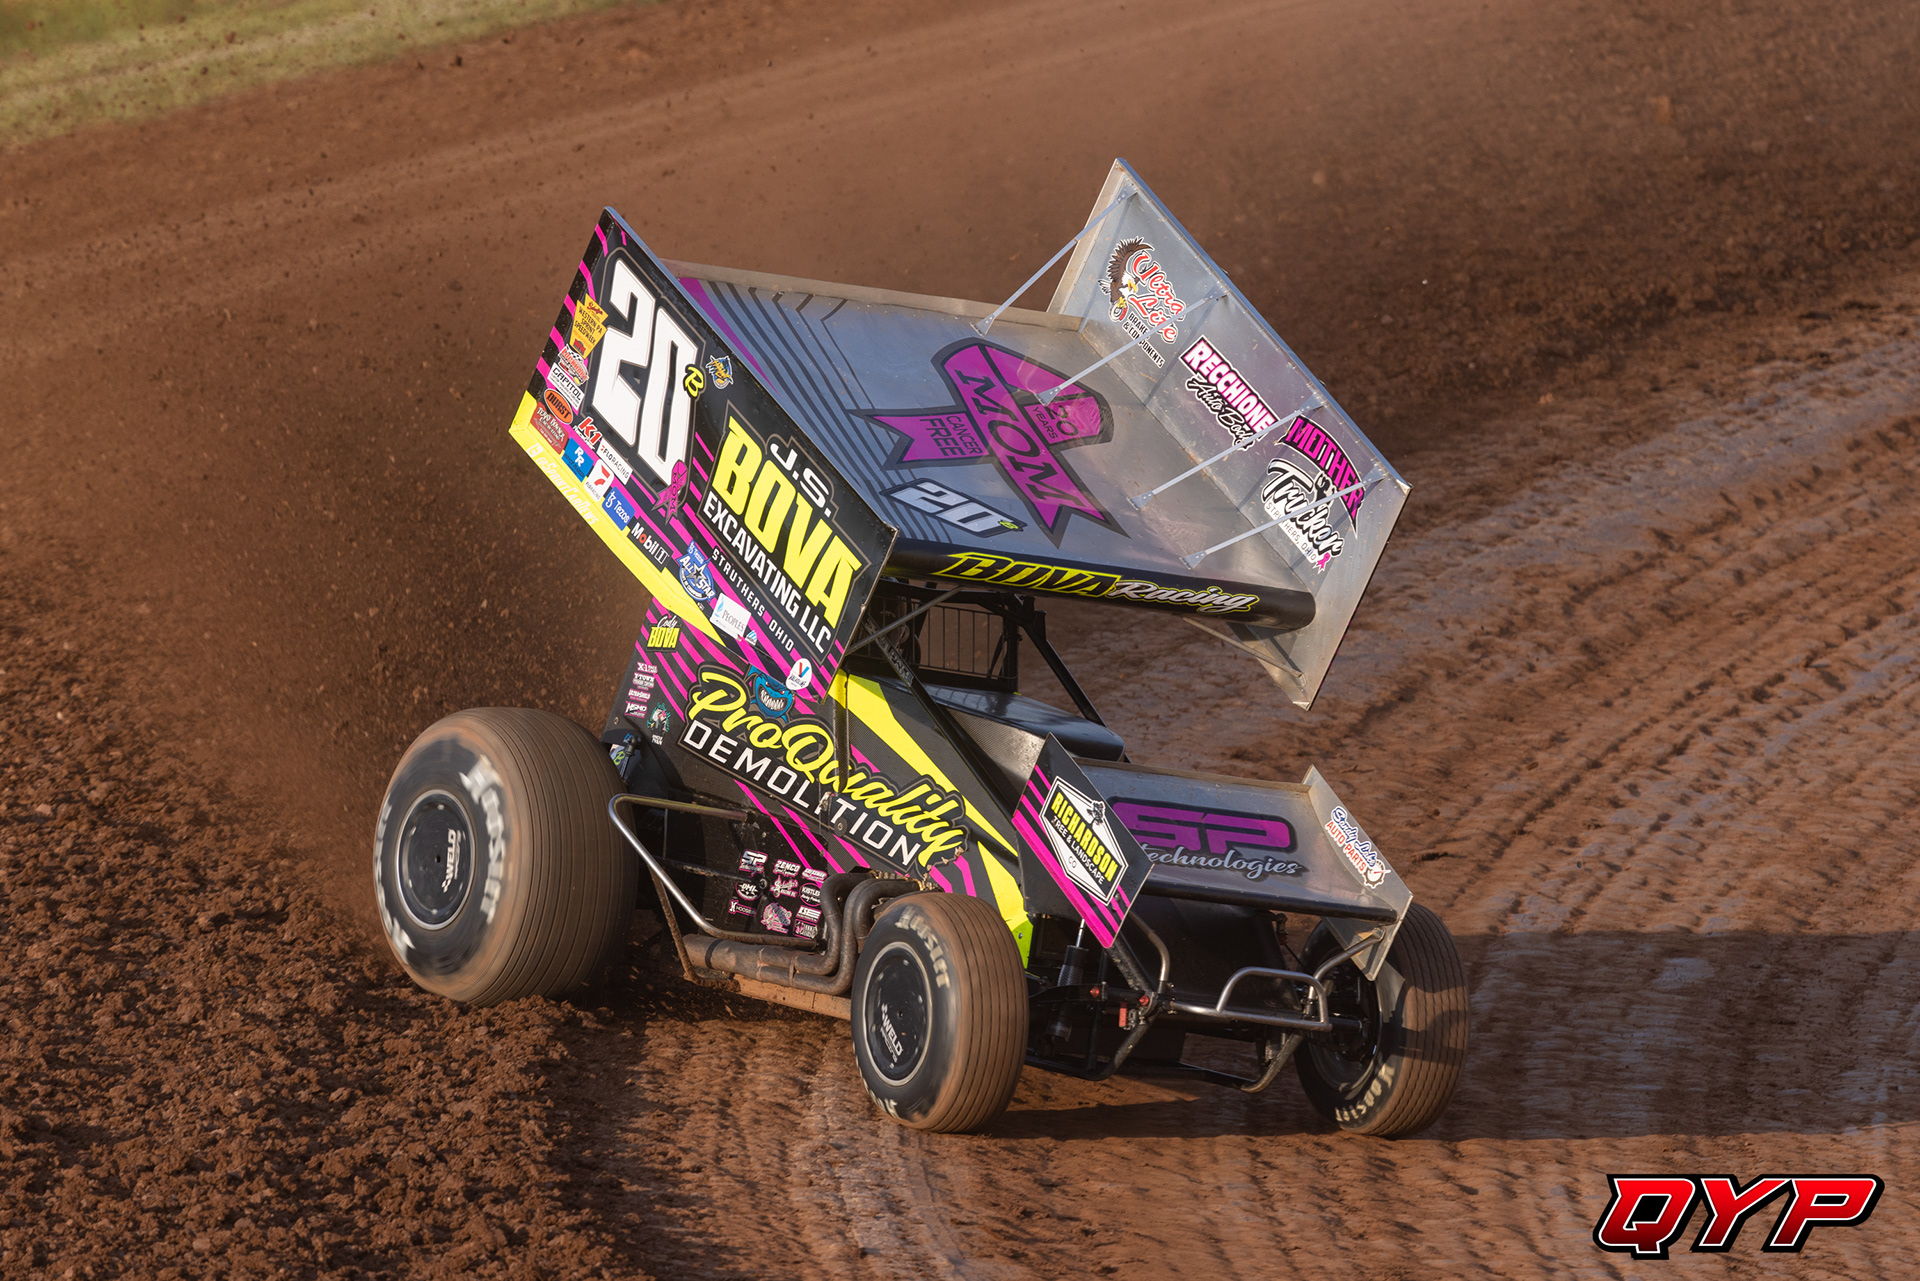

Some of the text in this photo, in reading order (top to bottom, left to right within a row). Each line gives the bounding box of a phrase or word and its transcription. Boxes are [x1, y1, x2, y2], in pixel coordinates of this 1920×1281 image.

[552, 367, 581, 401] CAPITOL
[561, 348, 588, 381] LOCKHART
[591, 258, 704, 487] 20 B
[546, 392, 572, 419] DURST
[1183, 340, 1277, 434] RECCHIONE
[1187, 379, 1223, 409] Auto
[578, 417, 603, 445] K1
[919, 418, 967, 457] FREE
[946, 415, 983, 454] CANCER
[954, 368, 1088, 508] MOM
[1032, 405, 1059, 440] YEARS
[1043, 403, 1079, 437] 20
[603, 448, 630, 479] FLORACING
[769, 442, 832, 518] J.S.
[1285, 417, 1364, 520] MOTHER
[613, 500, 630, 523] Tezos
[711, 415, 863, 629] BOVA
[890, 481, 1013, 533] 20
[631, 522, 660, 555] Mobil
[1301, 541, 1317, 561] OHIO
[679, 555, 695, 574] ALL
[696, 579, 716, 599] STAR
[702, 491, 832, 653] EXCAVATING LLC
[932, 552, 1258, 613] BOVA Racing
[712, 548, 794, 652] STRUTHERS OHIO
[721, 609, 745, 633] PEOPLES
[647, 626, 680, 649] BOVA
[657, 614, 678, 631] Cody
[688, 671, 964, 868] ProQuality
[1051, 792, 1118, 882] RICHARDSON
[1113, 802, 1291, 854] SP
[1326, 821, 1367, 872] AUTO PARTS
[1332, 807, 1377, 868] Sandy Lake
[446, 828, 457, 876] WELD
[1051, 815, 1105, 885] TREE & LANDSCAPE
[1068, 855, 1077, 868] CO
[883, 1016, 904, 1056] WELD
